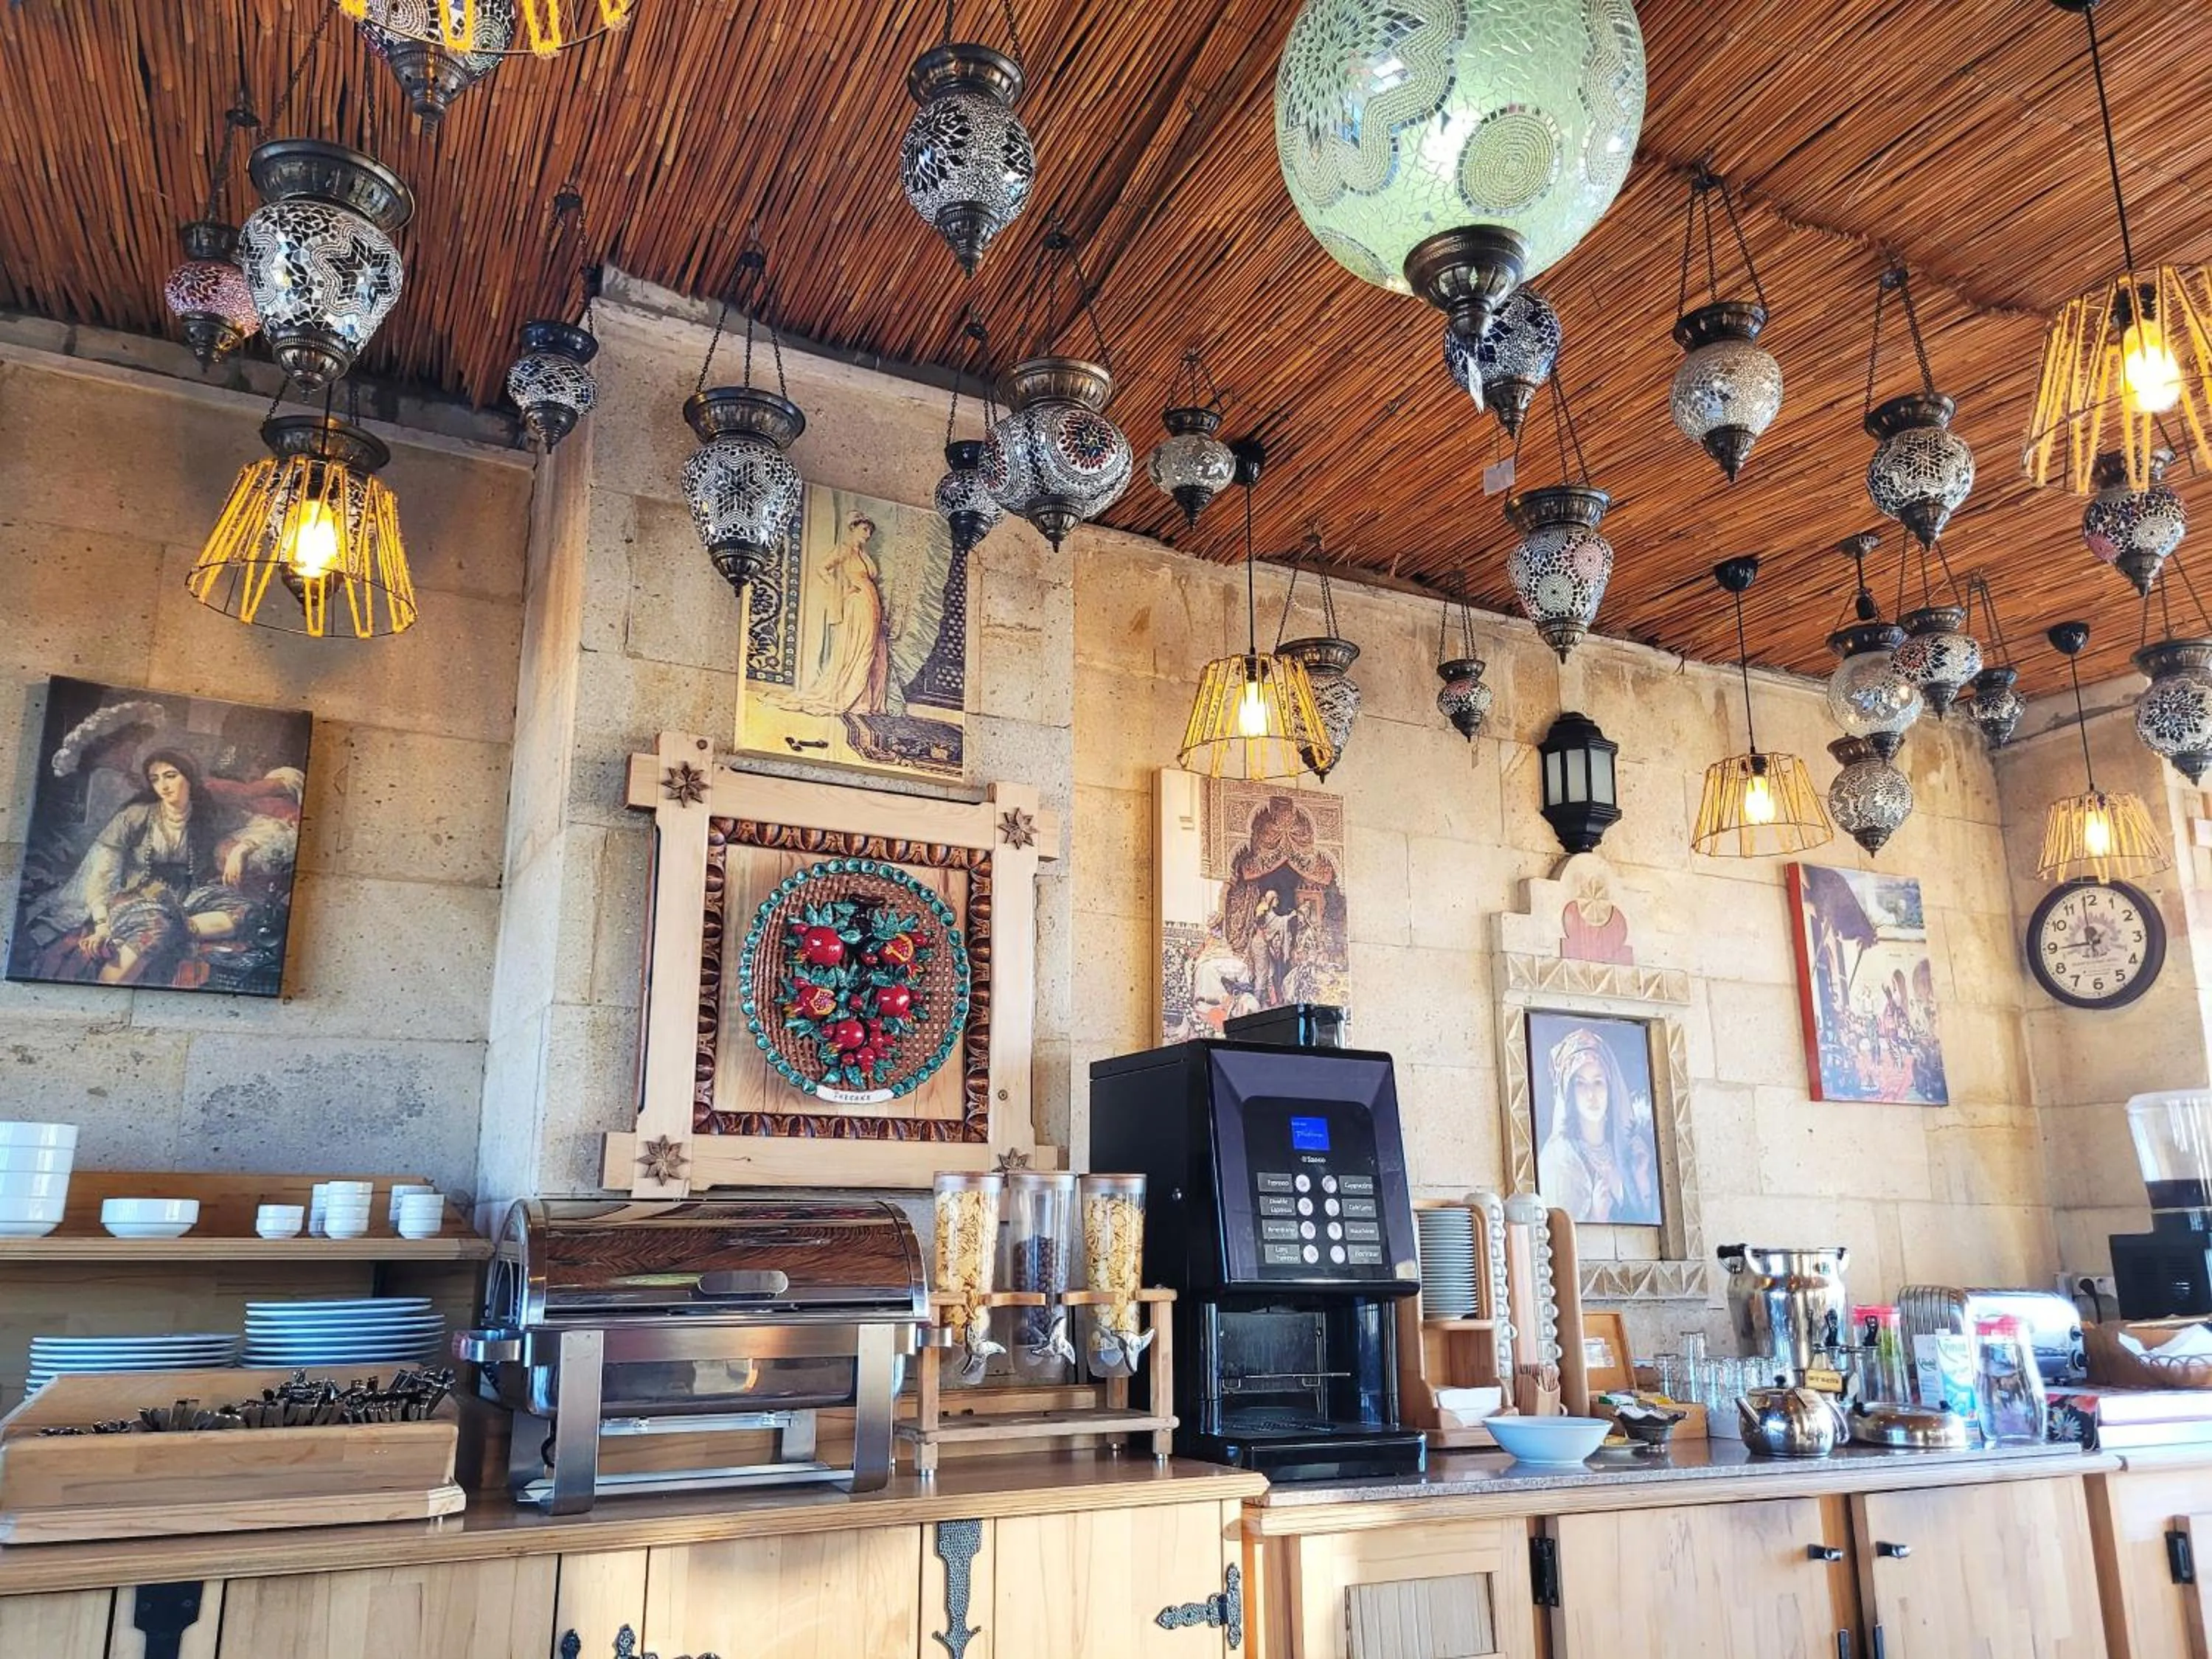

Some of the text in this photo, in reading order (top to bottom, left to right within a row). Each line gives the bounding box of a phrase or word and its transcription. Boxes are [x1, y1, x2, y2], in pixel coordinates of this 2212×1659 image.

[2108, 897, 2115, 909] 1
[2064, 904, 2075, 916] 11
[2122, 909, 2133, 922] 2
[2052, 919, 2066, 932] 10
[2132, 931, 2142, 942] 3
[2047, 942, 2058, 954] 9
[2128, 953, 2138, 964] 4
[2055, 962, 2066, 974] 8
[2070, 975, 2080, 987] 7
[2115, 970, 2126, 982] 5
[2093, 978, 2104, 990] 6
